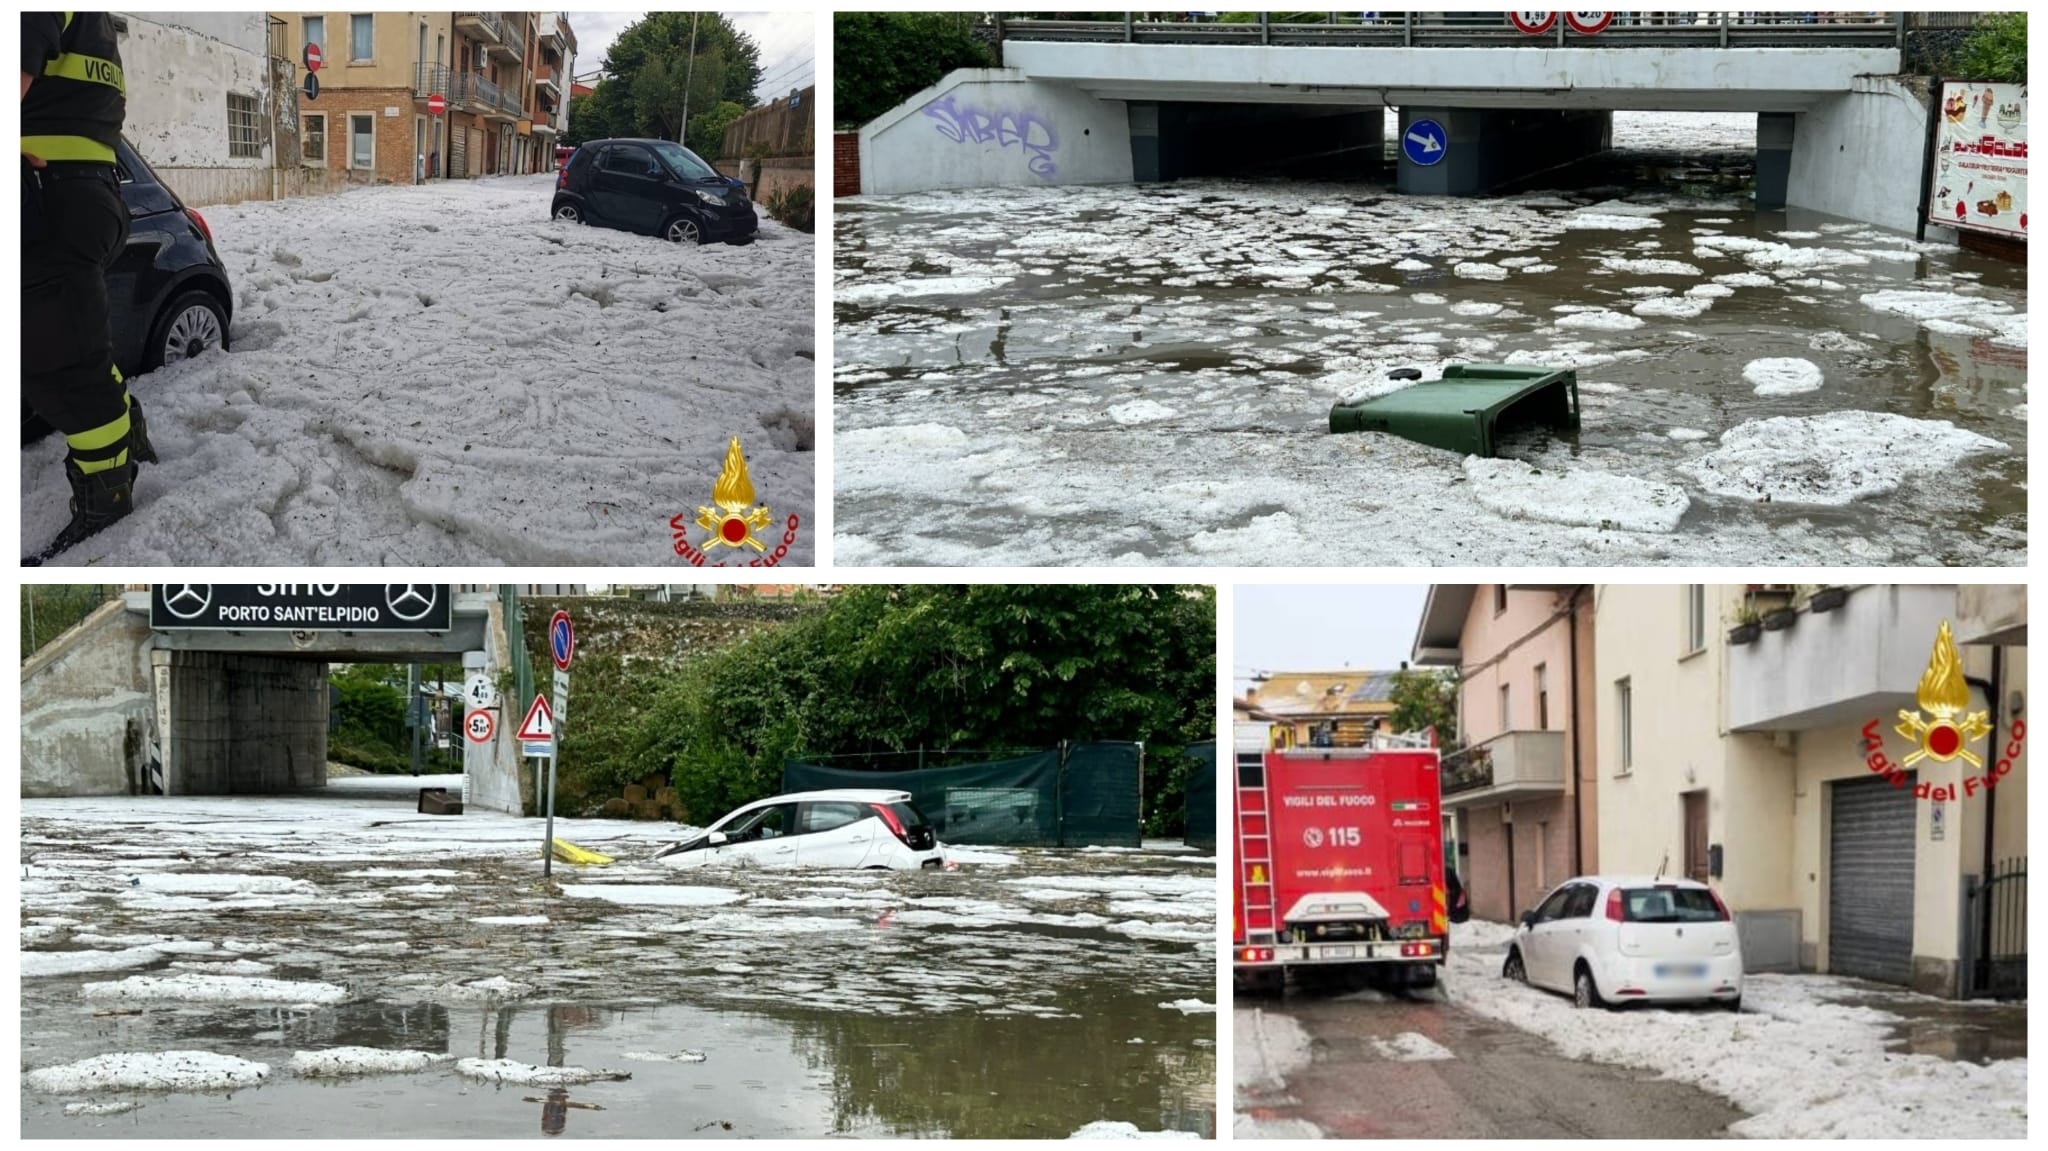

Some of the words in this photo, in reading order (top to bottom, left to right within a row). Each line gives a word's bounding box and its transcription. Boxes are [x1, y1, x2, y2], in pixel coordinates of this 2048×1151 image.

[218, 605, 270, 622] PORTO
[274, 606, 380, 623] SANT'ELPIDIO
[1283, 796, 1314, 807] VIGILI
[1316, 796, 1337, 806] DEL
[1339, 795, 1375, 806] FUOCO
[1328, 826, 1361, 846] 115
